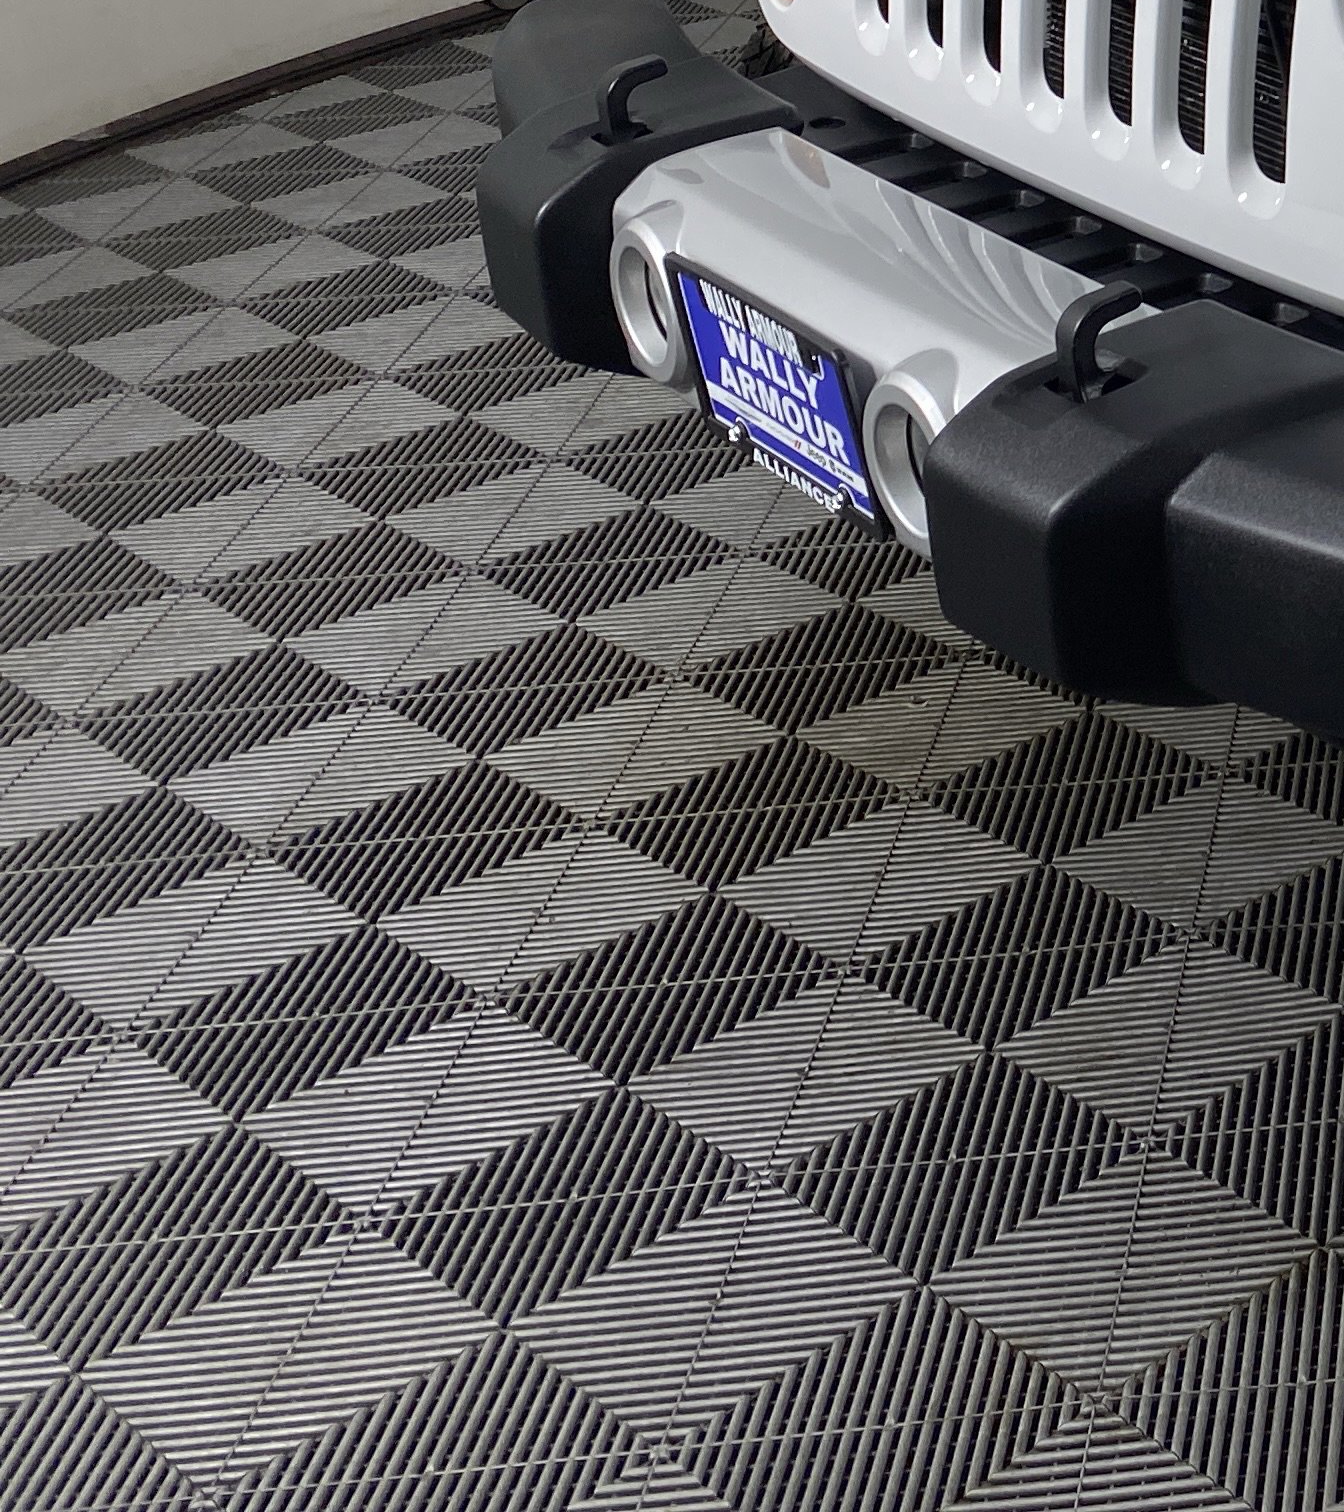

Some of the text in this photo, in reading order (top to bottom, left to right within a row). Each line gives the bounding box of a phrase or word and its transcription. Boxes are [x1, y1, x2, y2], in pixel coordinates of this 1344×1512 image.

[699, 278, 803, 368] WALLY ARMOUR
[719, 320, 819, 410] WALLY
[720, 356, 850, 466] ARMOUR
[753, 447, 836, 513] ALLIANCE
